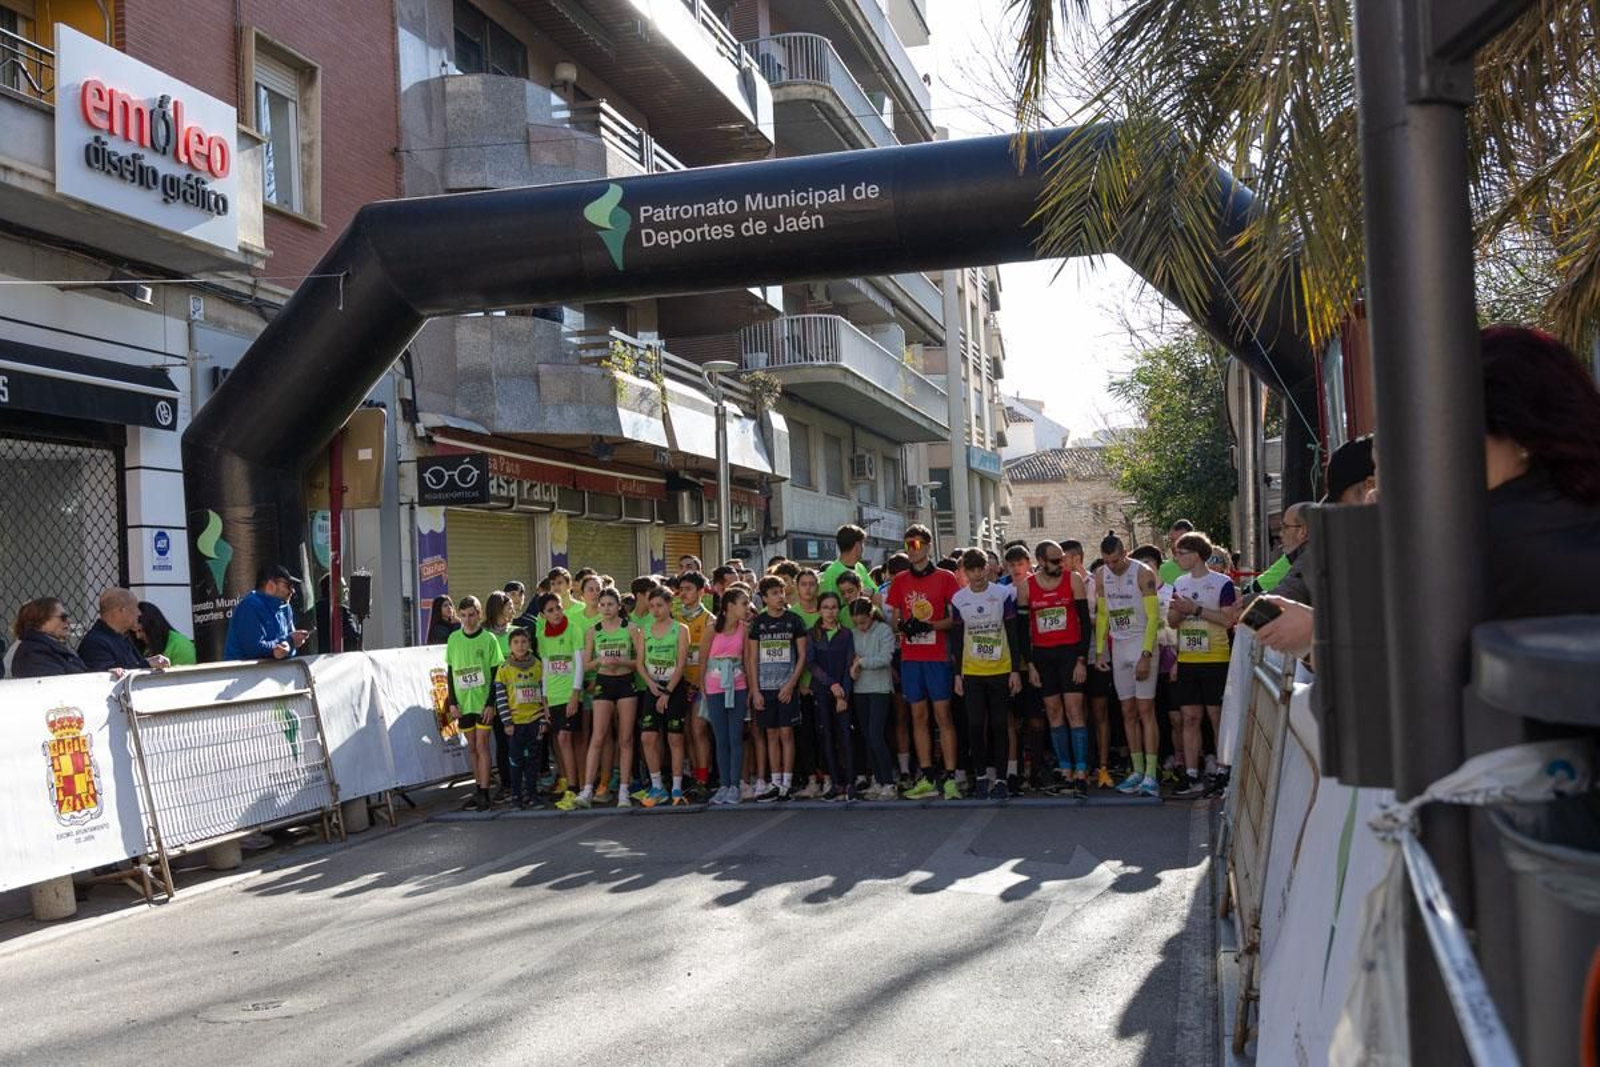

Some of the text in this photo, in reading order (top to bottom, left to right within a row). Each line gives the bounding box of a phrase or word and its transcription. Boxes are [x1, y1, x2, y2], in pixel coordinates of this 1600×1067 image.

[84, 135, 228, 216] diseño gráfico
[639, 182, 880, 223] Patronato Municipal de
[640, 211, 824, 248] Deportes de Jaén
